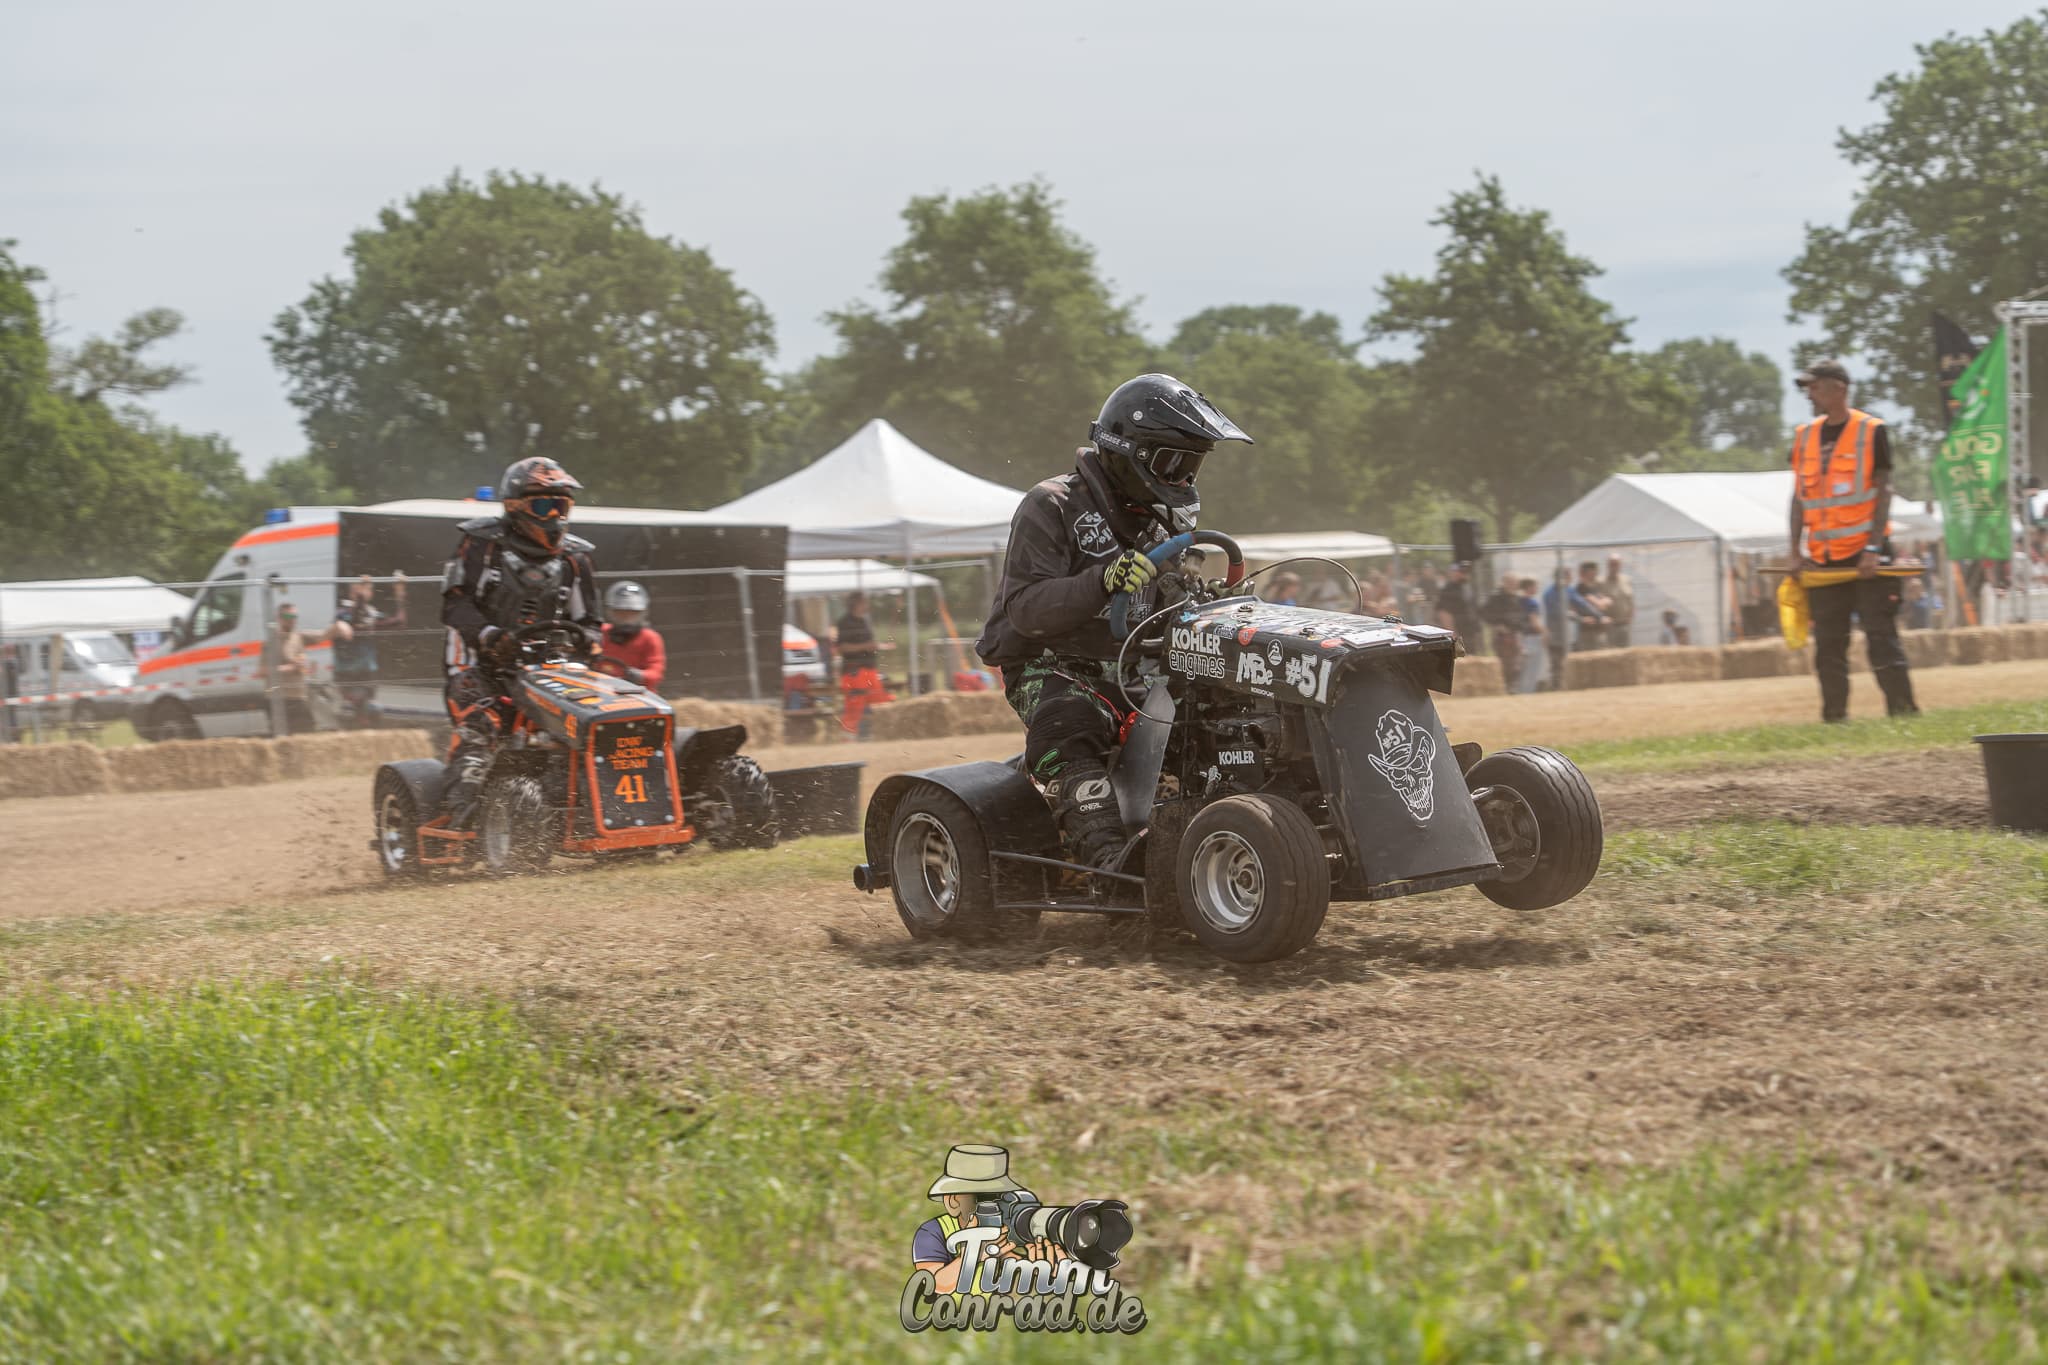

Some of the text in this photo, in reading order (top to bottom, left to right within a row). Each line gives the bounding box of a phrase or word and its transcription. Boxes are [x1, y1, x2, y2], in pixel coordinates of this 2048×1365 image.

[1171, 627, 1223, 656] KOHLER
[1169, 650, 1226, 680] engines
[1285, 653, 1333, 704] #51
[1382, 724, 1407, 749] #51
[612, 758, 649, 770] TEAM
[1218, 750, 1256, 765] KOHLER
[615, 774, 649, 803] 41
